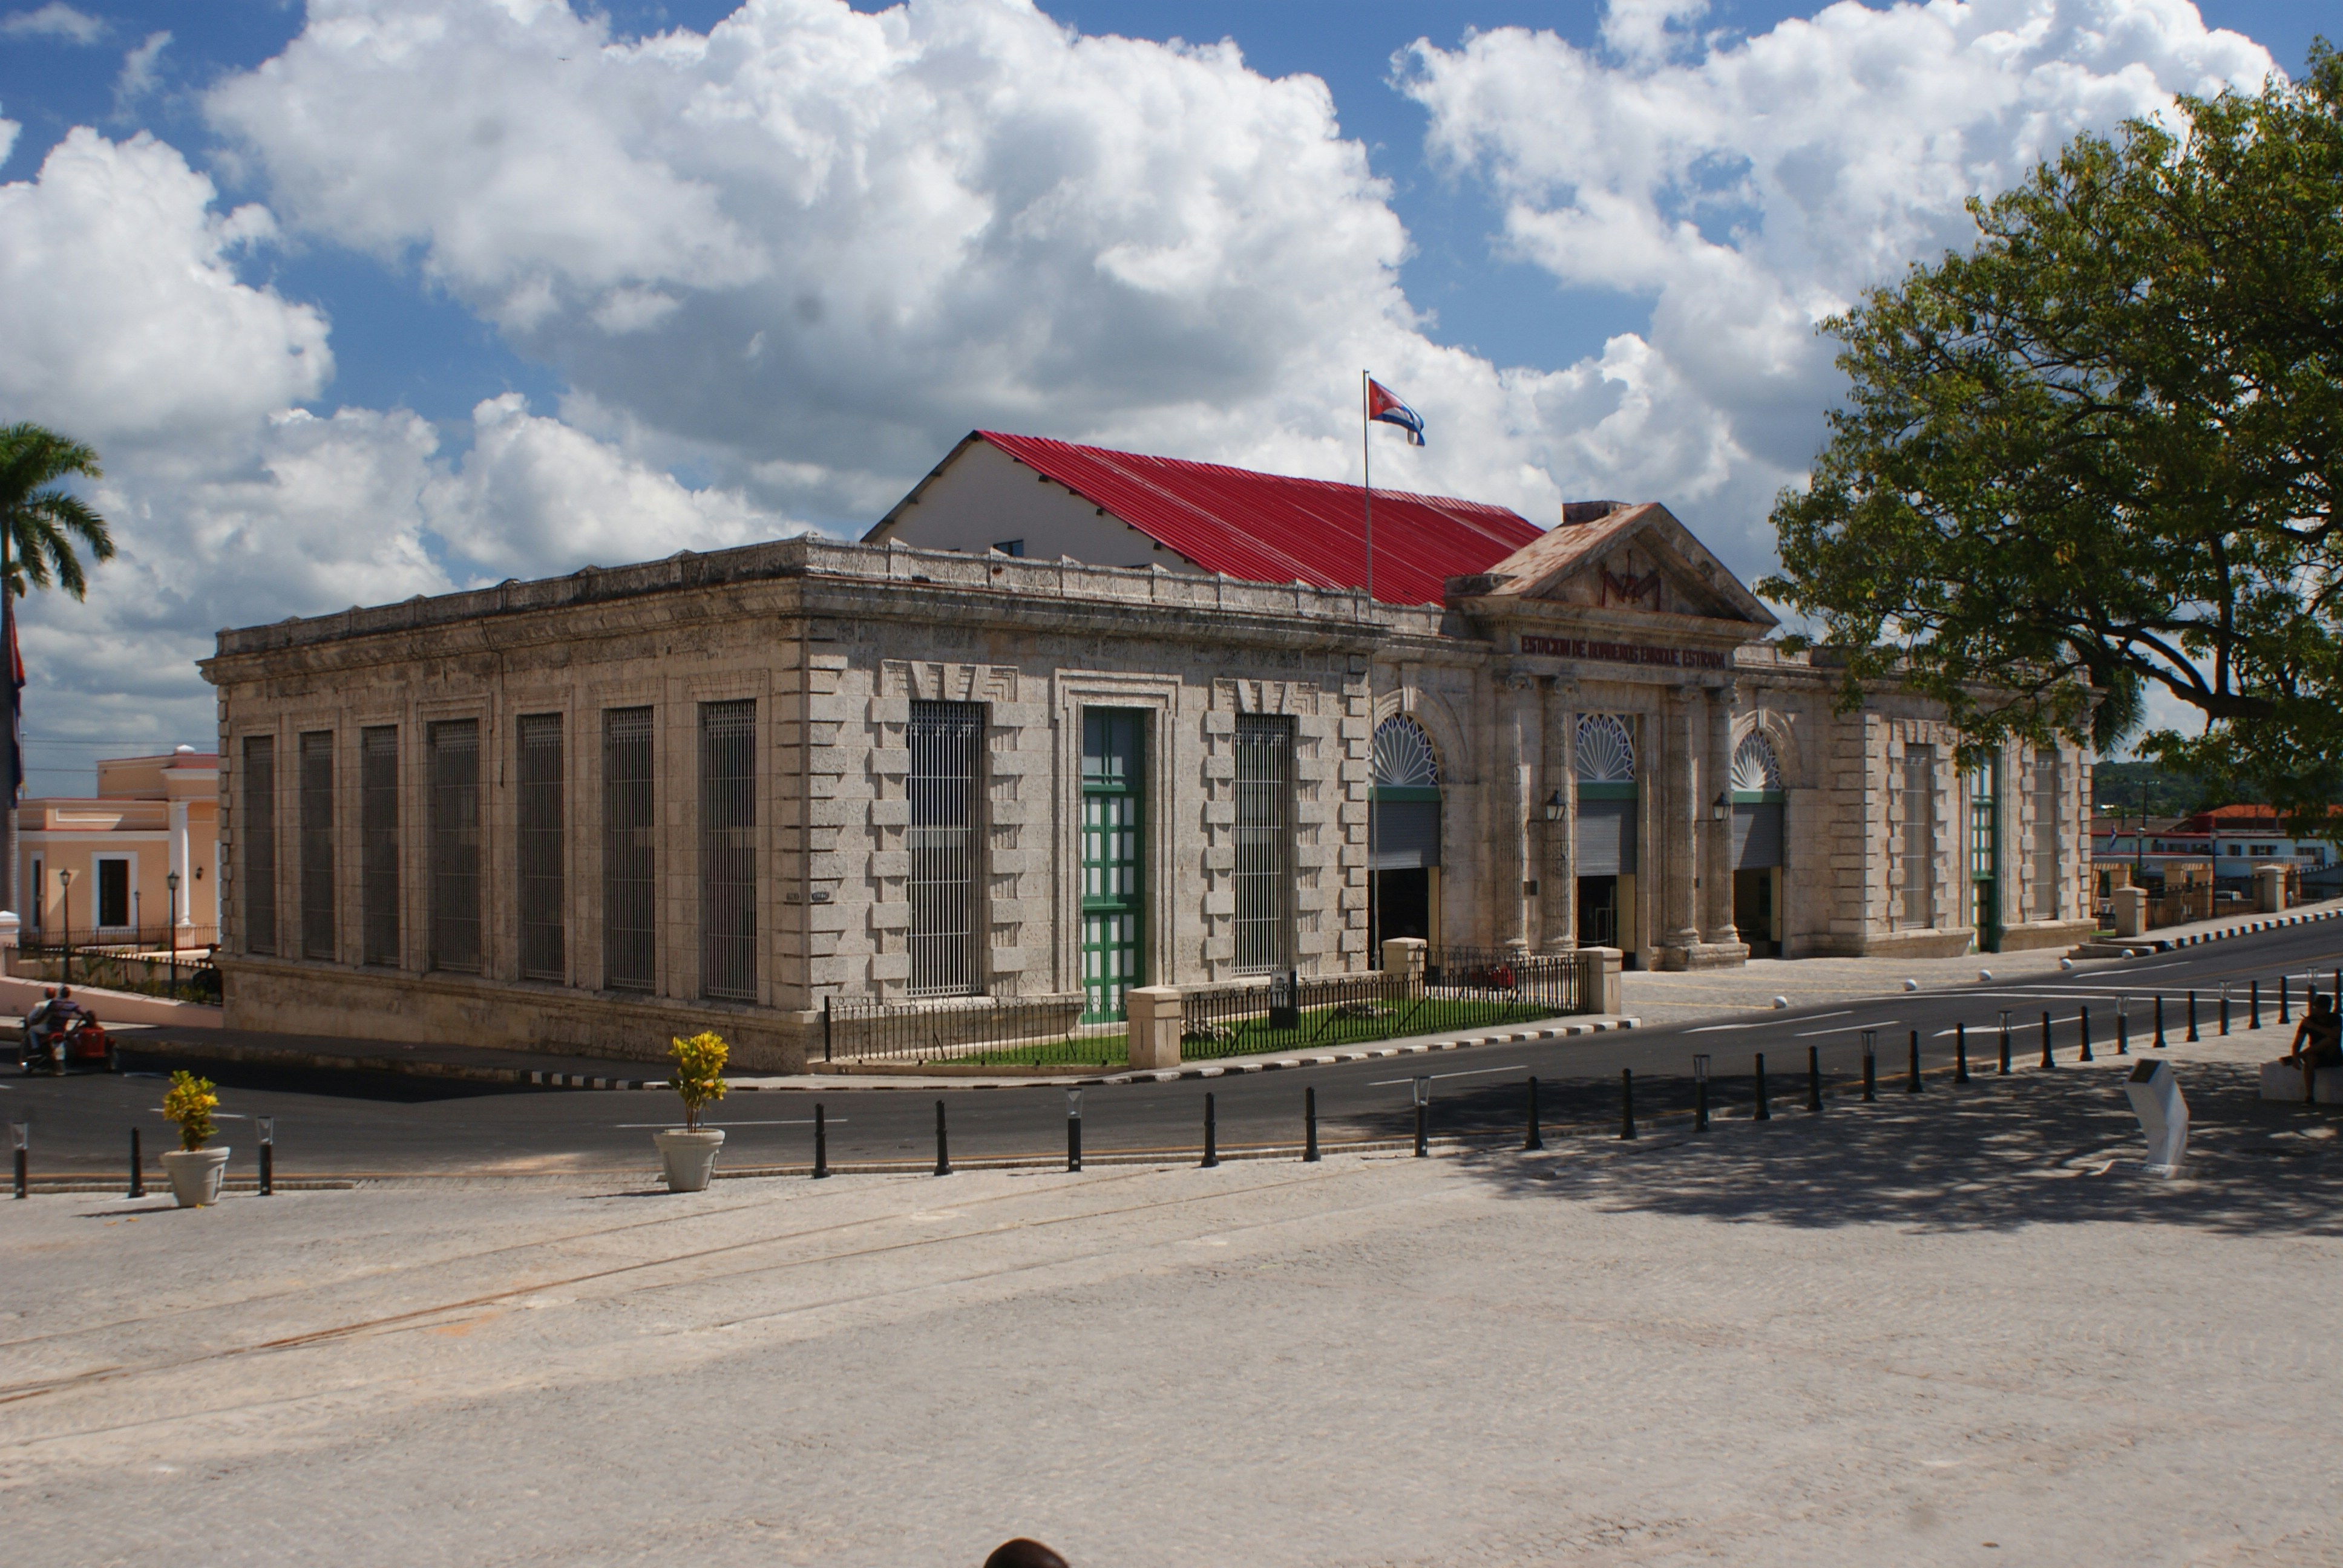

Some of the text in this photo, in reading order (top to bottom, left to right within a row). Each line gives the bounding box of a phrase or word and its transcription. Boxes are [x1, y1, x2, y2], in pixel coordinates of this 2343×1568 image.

[1572, 639, 1587, 657] DE
[1588, 641, 1638, 664] BOMBEROS
[1682, 649, 1726, 669] ESTRADA
